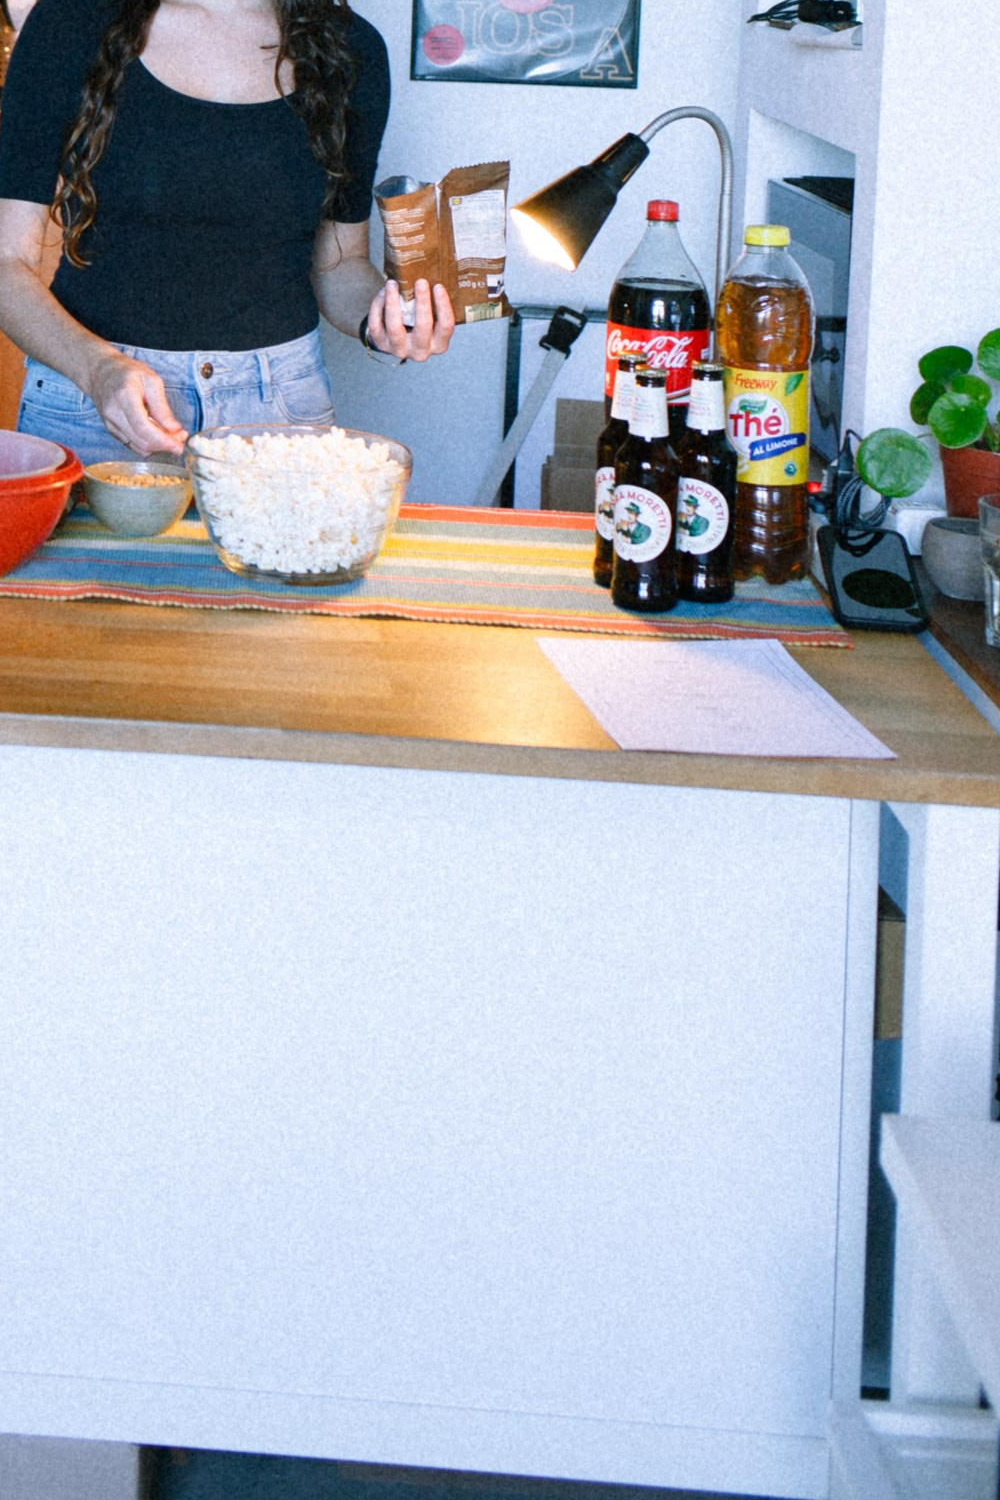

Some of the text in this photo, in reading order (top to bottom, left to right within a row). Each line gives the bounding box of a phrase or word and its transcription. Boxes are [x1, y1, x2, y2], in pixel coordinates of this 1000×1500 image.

[734, 373, 778, 391] Freeway
[729, 407, 782, 437] Thé
[753, 437, 798, 457] AL LIMONE
[627, 490, 667, 528] MORETTI
[685, 484, 725, 521] MORETTI
